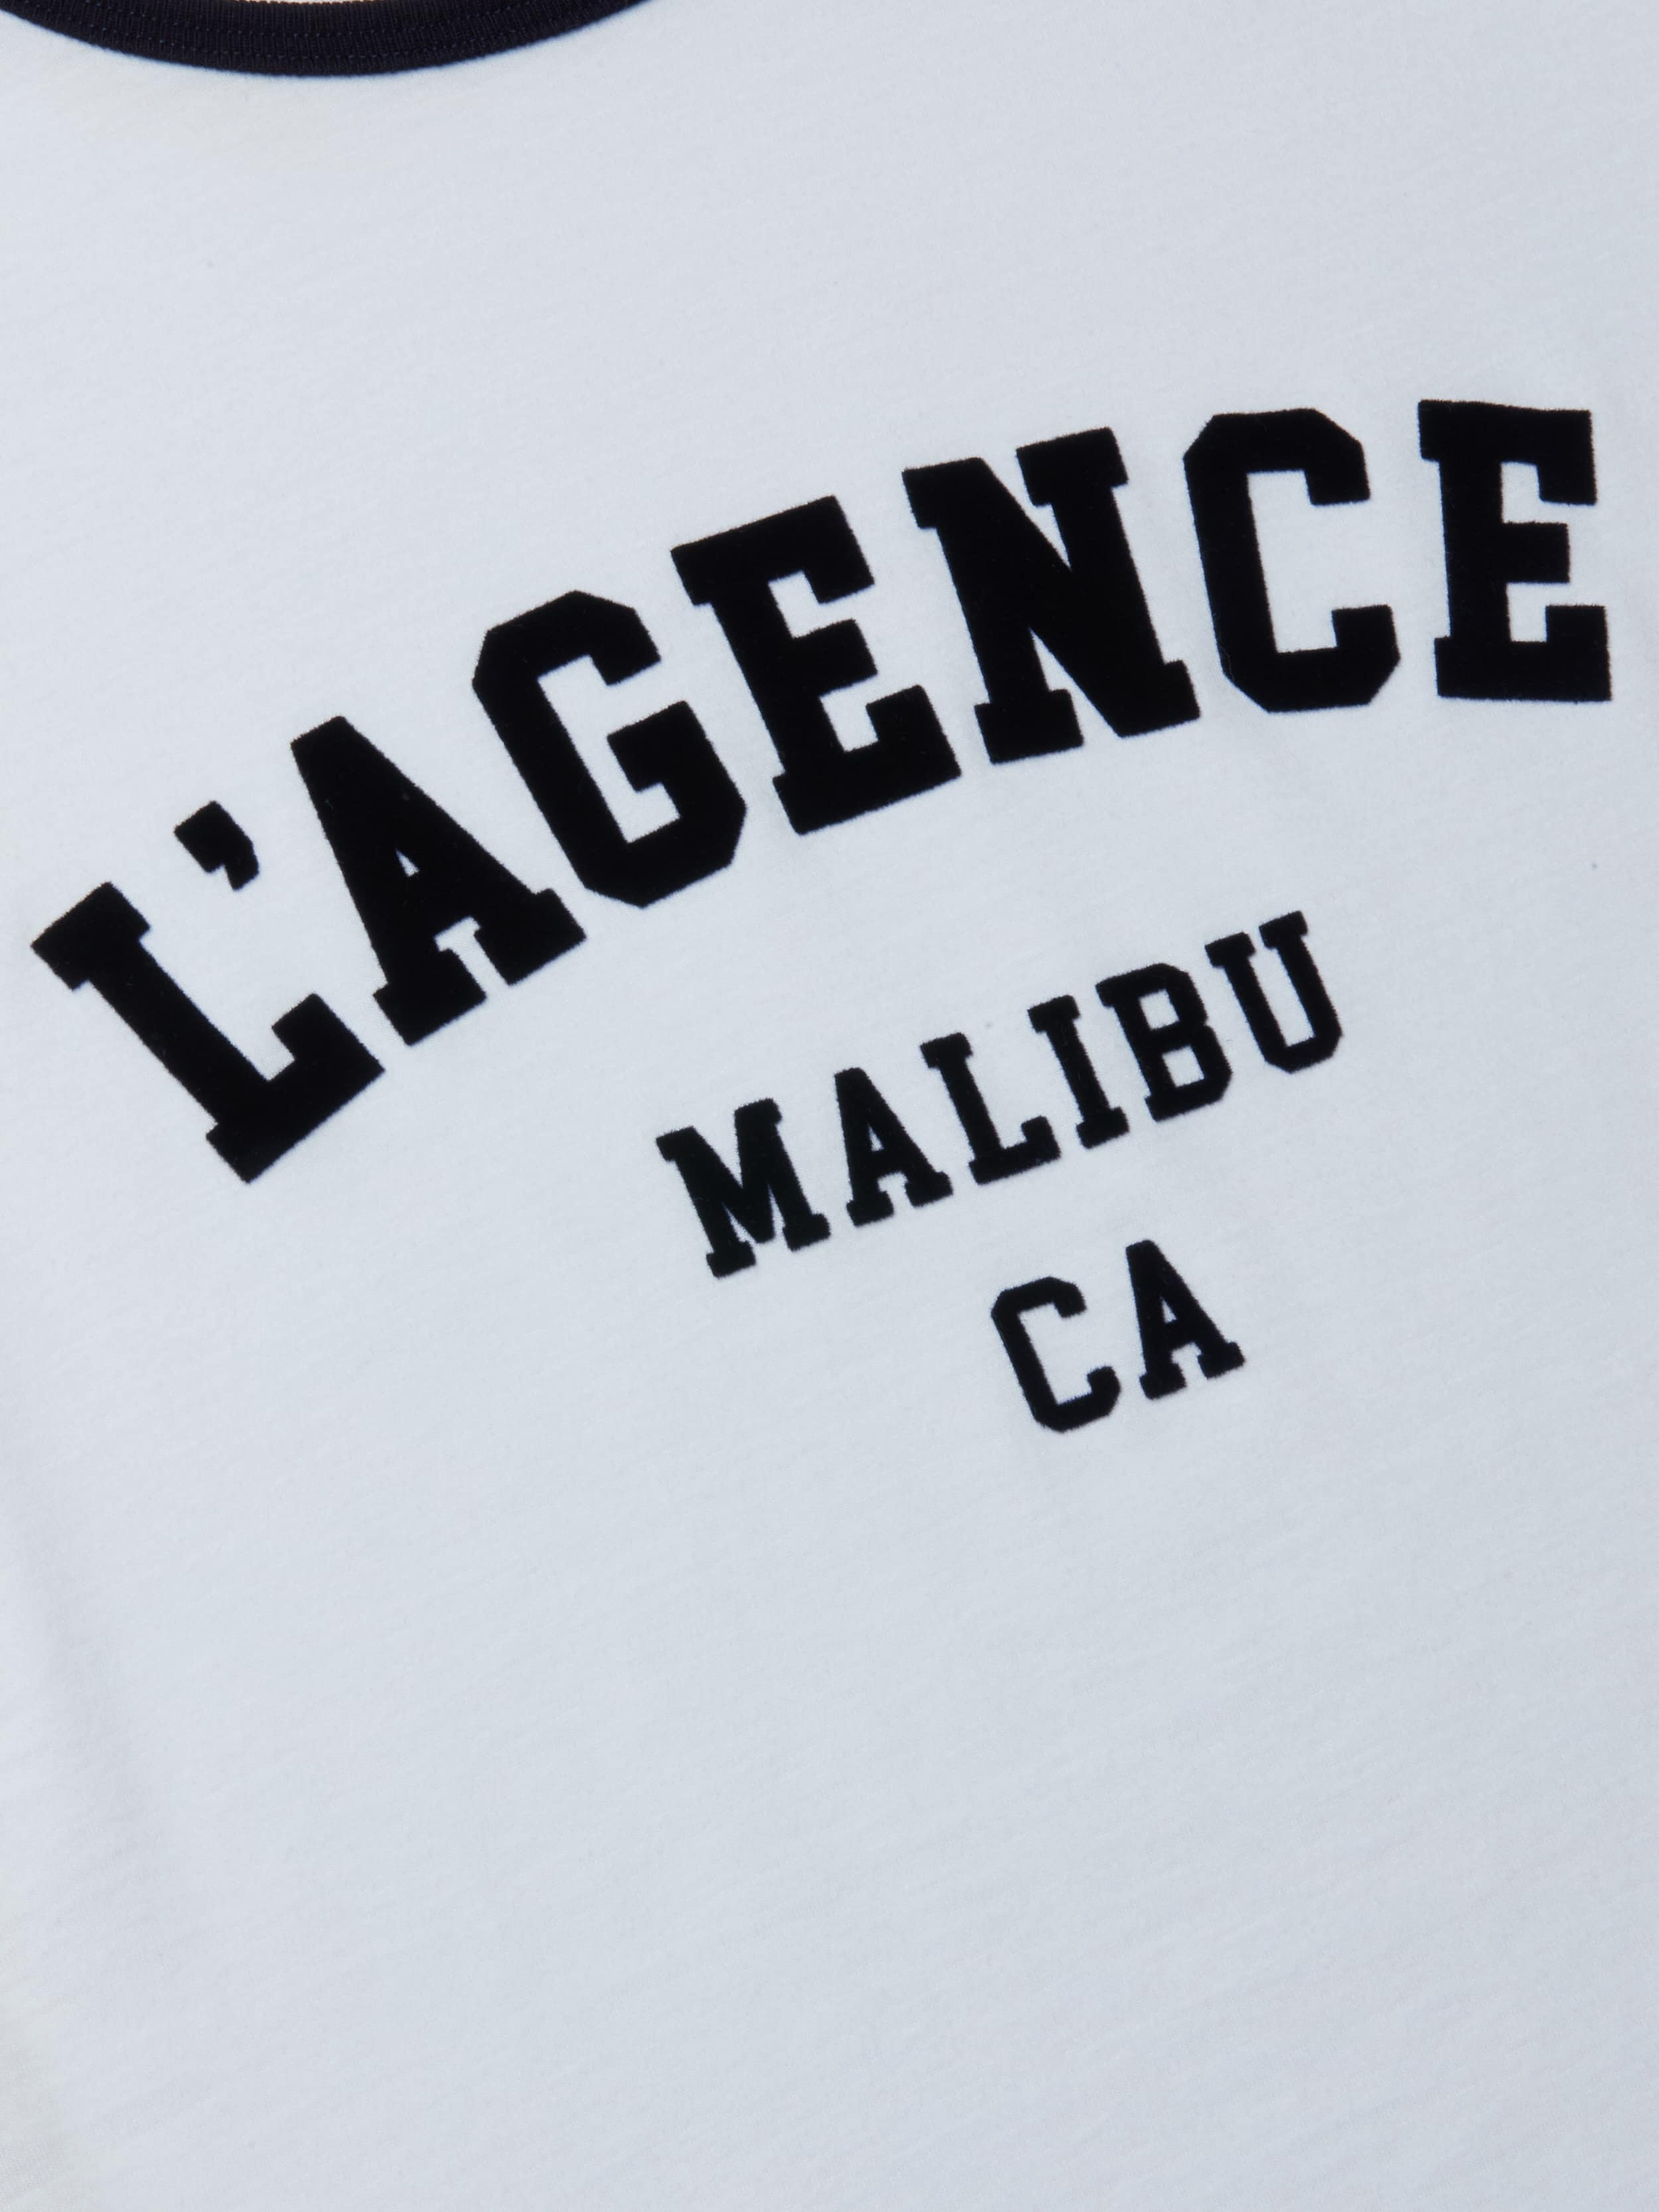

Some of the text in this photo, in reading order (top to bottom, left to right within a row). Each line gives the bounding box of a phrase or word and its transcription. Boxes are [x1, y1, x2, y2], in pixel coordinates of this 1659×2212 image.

[31, 399, 1612, 1184] L'AGENCE
[655, 911, 1343, 1279] MALIBU
[990, 1240, 1245, 1433] CA
